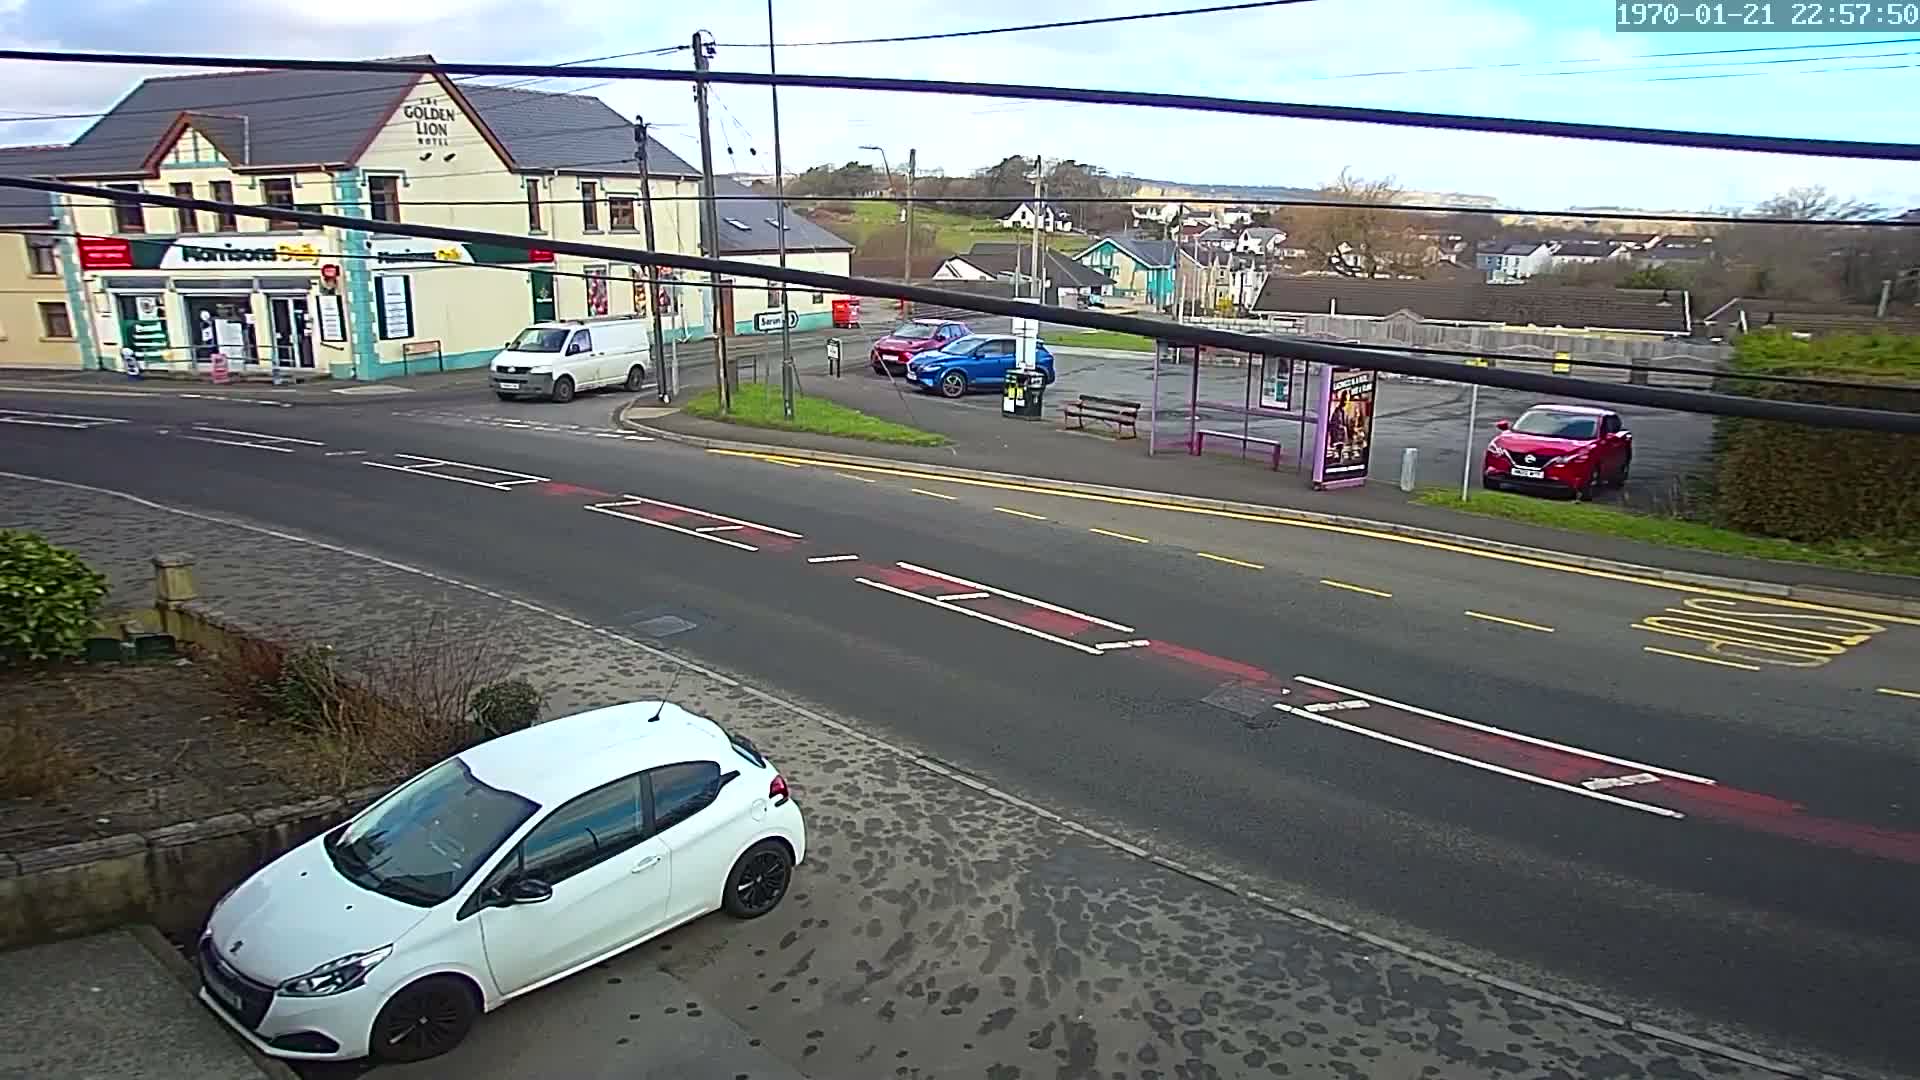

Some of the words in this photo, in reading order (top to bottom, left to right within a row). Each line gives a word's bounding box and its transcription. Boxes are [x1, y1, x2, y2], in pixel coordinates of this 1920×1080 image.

[404, 106, 455, 121] GOLDEN
[416, 121, 447, 136] LION
[418, 138, 448, 146] HOTEL
